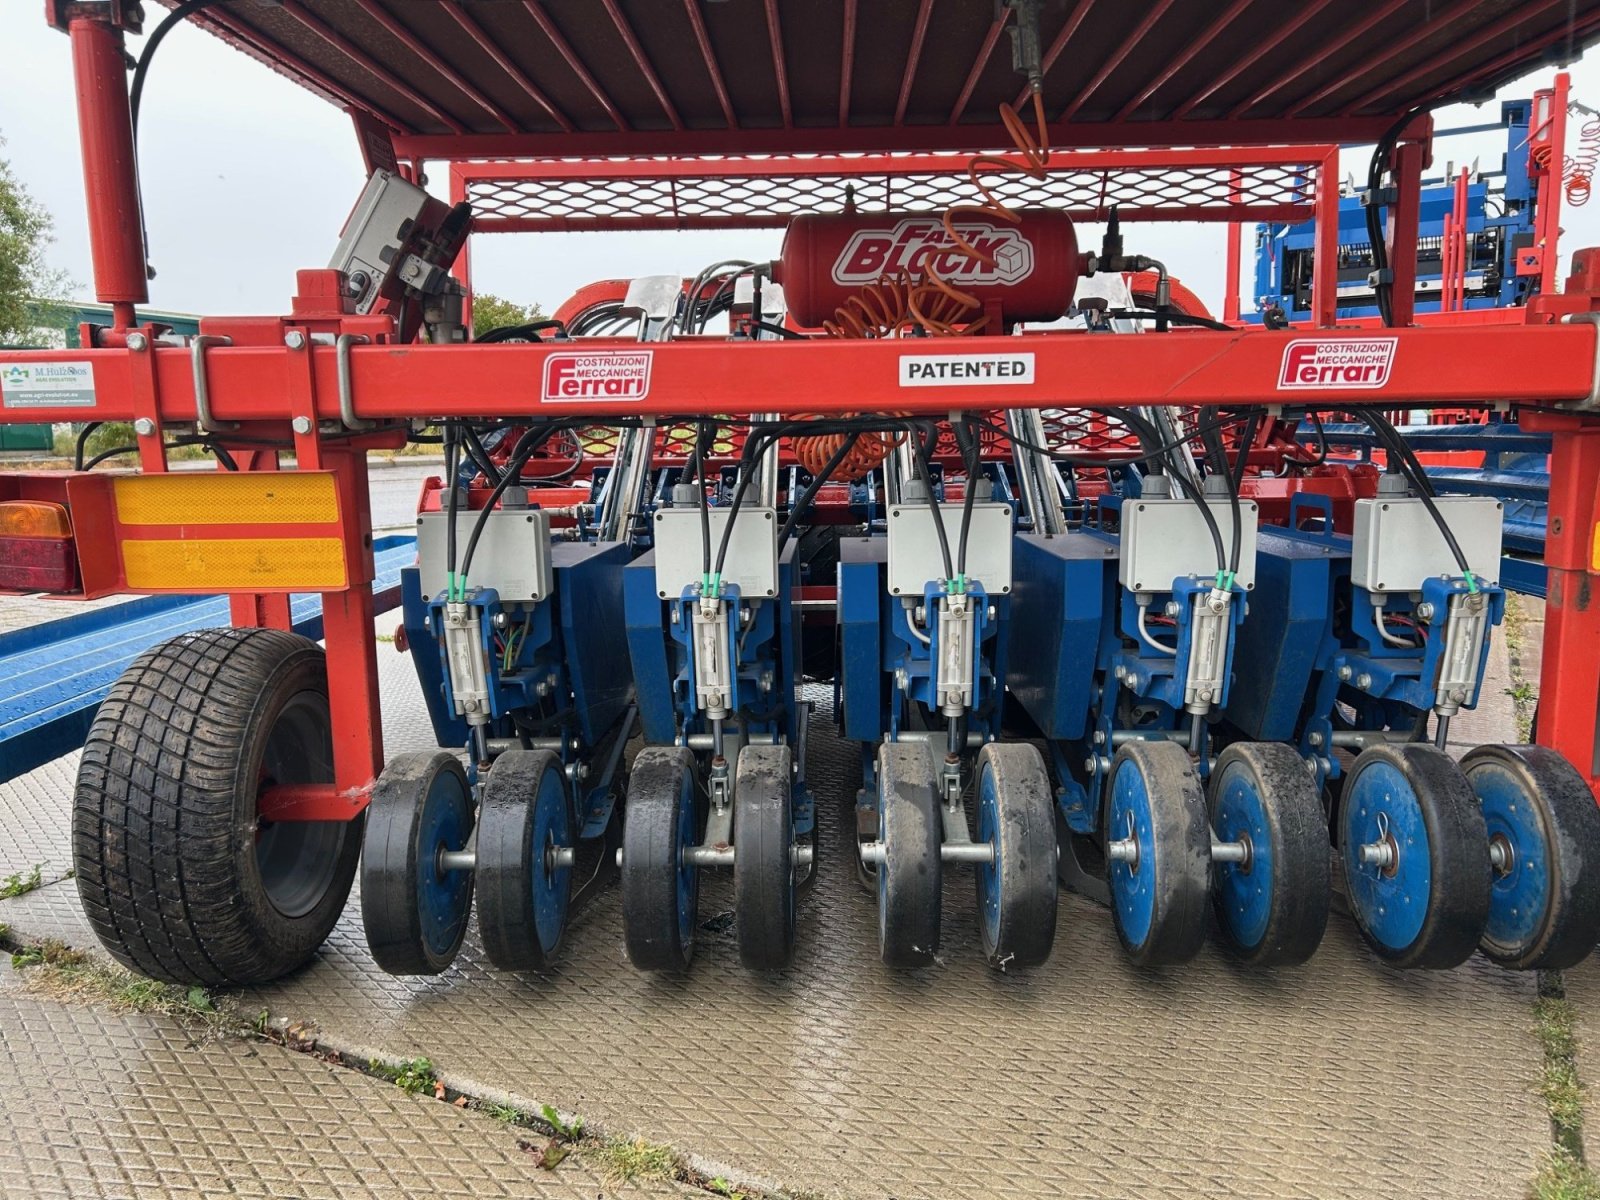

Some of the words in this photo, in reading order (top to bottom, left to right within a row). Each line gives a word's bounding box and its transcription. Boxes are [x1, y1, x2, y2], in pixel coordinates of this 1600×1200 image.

[897, 224, 983, 244] FAST
[843, 237, 1011, 275] BLOCK
[1317, 344, 1388, 353] COSTRUZIONI
[576, 358, 645, 367] COSTRUZIONI
[1285, 345, 1384, 383] Ferrari
[1316, 355, 1386, 364] MECCANICHE
[548, 359, 643, 396] Ferrari
[577, 368, 644, 378] MECCANICHE
[908, 361, 1026, 379] PATENTED
